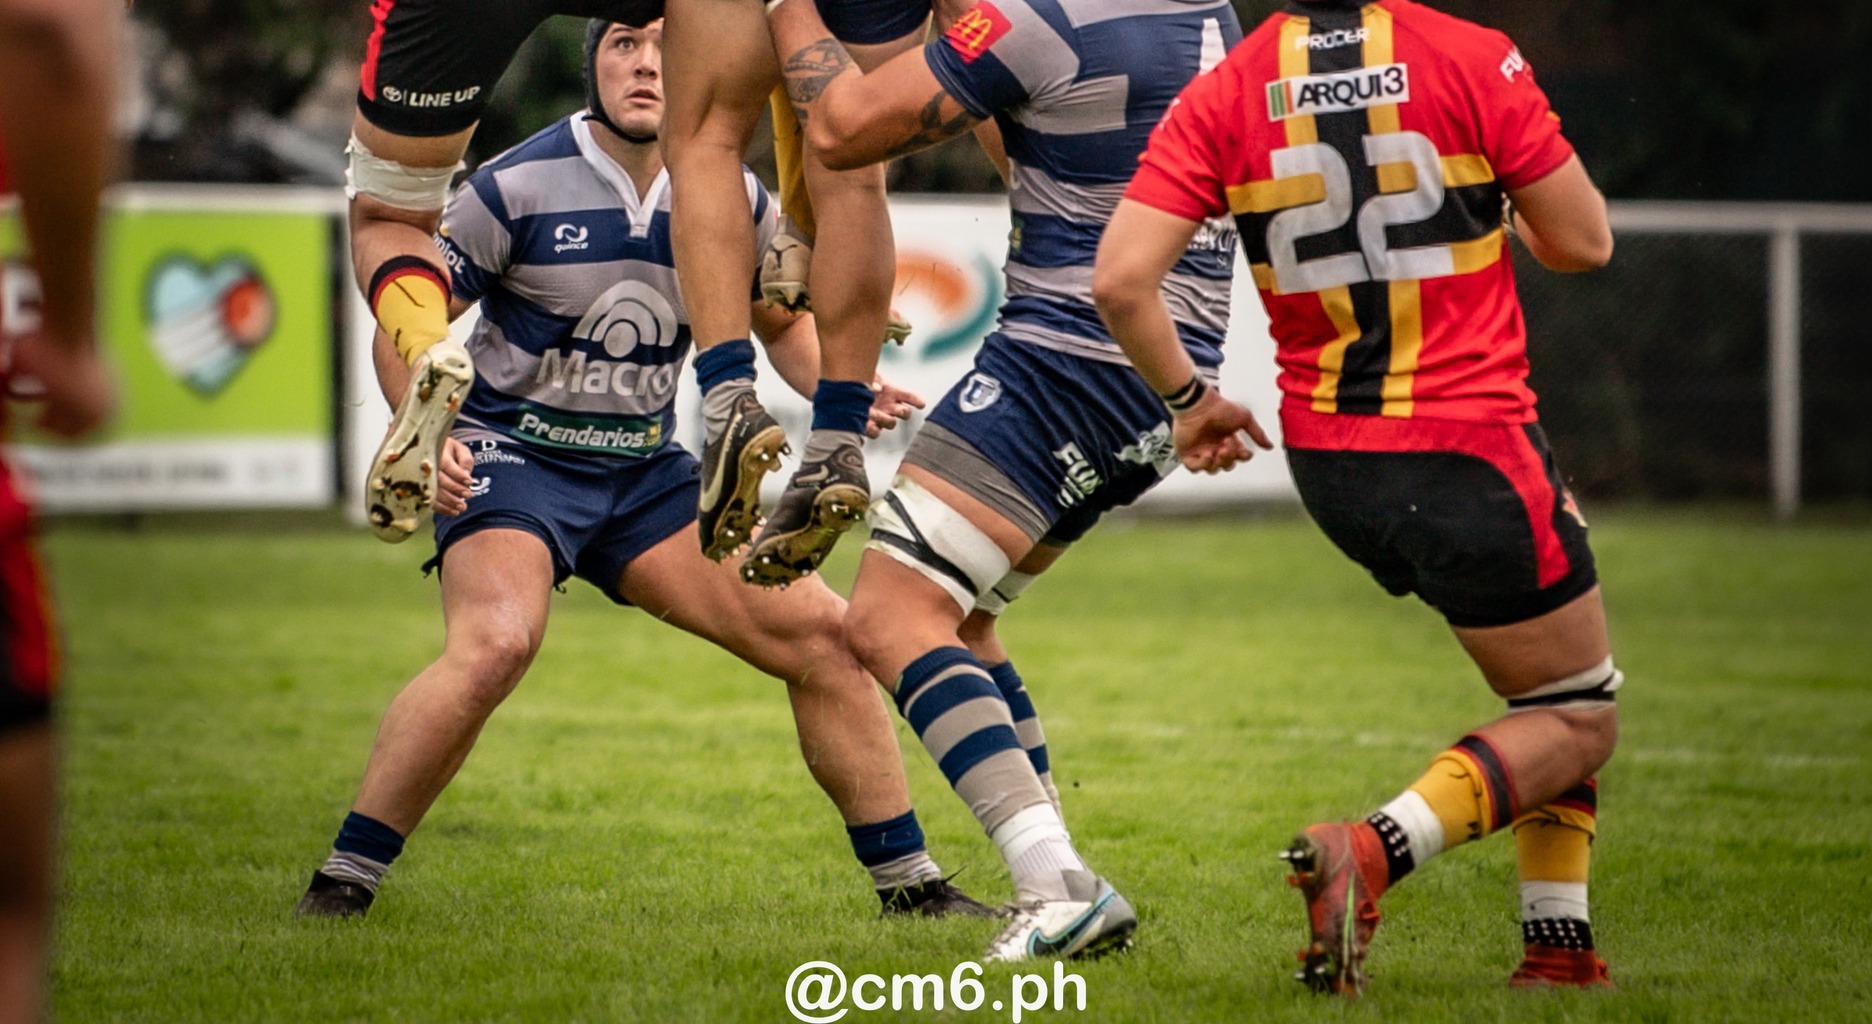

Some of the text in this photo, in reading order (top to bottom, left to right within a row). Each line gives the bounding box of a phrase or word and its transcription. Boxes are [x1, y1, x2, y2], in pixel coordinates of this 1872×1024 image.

[1294, 27, 1370, 51] PROCER
[409, 85, 480, 107] LINE UP
[1297, 67, 1405, 108] ARQUI3
[1266, 130, 1455, 296] 22
[554, 240, 589, 254] quince
[535, 348, 675, 397] Macro
[518, 412, 646, 448] Prendarios
